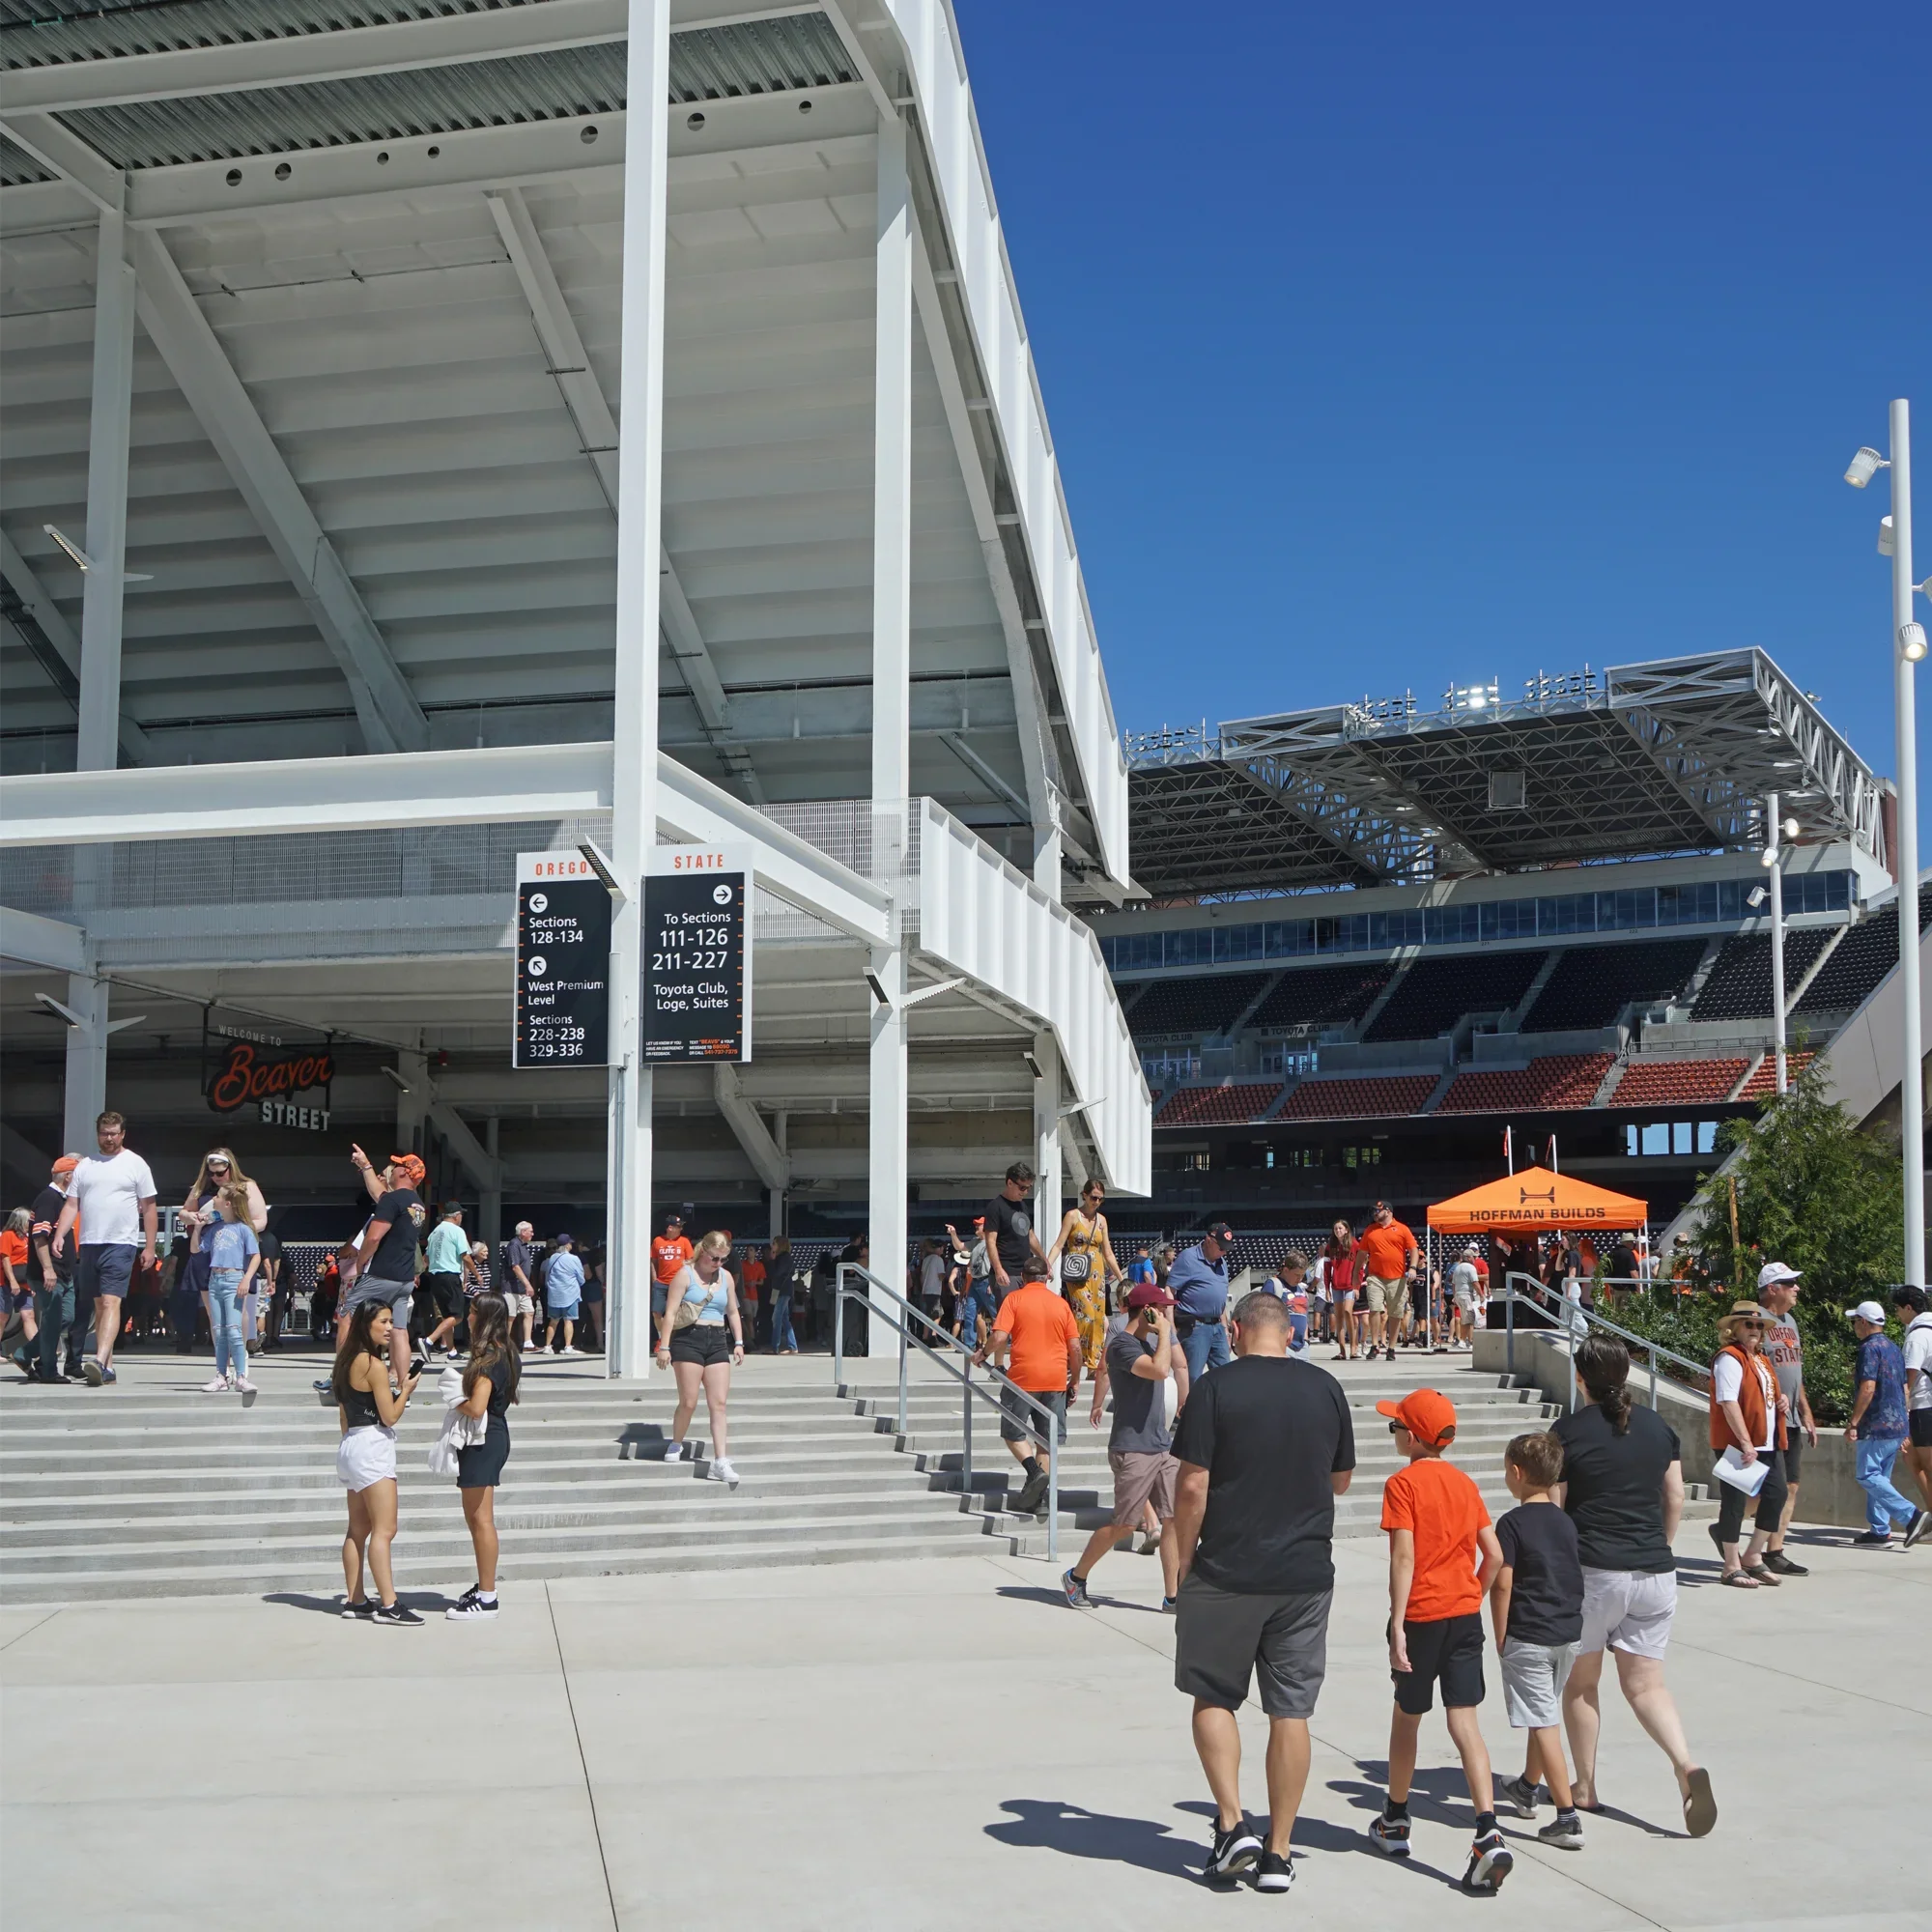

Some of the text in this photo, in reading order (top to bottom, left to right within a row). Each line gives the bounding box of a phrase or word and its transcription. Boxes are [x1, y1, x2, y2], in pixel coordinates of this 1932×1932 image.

[535, 861, 596, 876] OREGO
[674, 854, 724, 869] STATE
[529, 916, 578, 928] Sections
[665, 911, 731, 924] To Sections
[531, 930, 583, 945] 128-134
[660, 928, 728, 948] 111-126
[652, 951, 727, 971] 211-227
[528, 980, 604, 991] West Premium
[654, 981, 728, 997] Toyota Club,
[528, 994, 554, 1005] Level
[657, 997, 728, 1011] Loge, Suites
[529, 1014, 573, 1025] Sections
[218, 1024, 282, 1046] WELCOME TO
[529, 1028, 584, 1041] 228-238
[1271, 1024, 1330, 1035] TOYOTA CLUB
[1137, 1034, 1193, 1044] TOYOTA CLUB
[529, 1043, 583, 1057] 329-336
[213, 1044, 332, 1108] Beaver
[262, 1101, 331, 1131] STREET
[1469, 1208, 1605, 1221] HOFFMAN BUILDS
